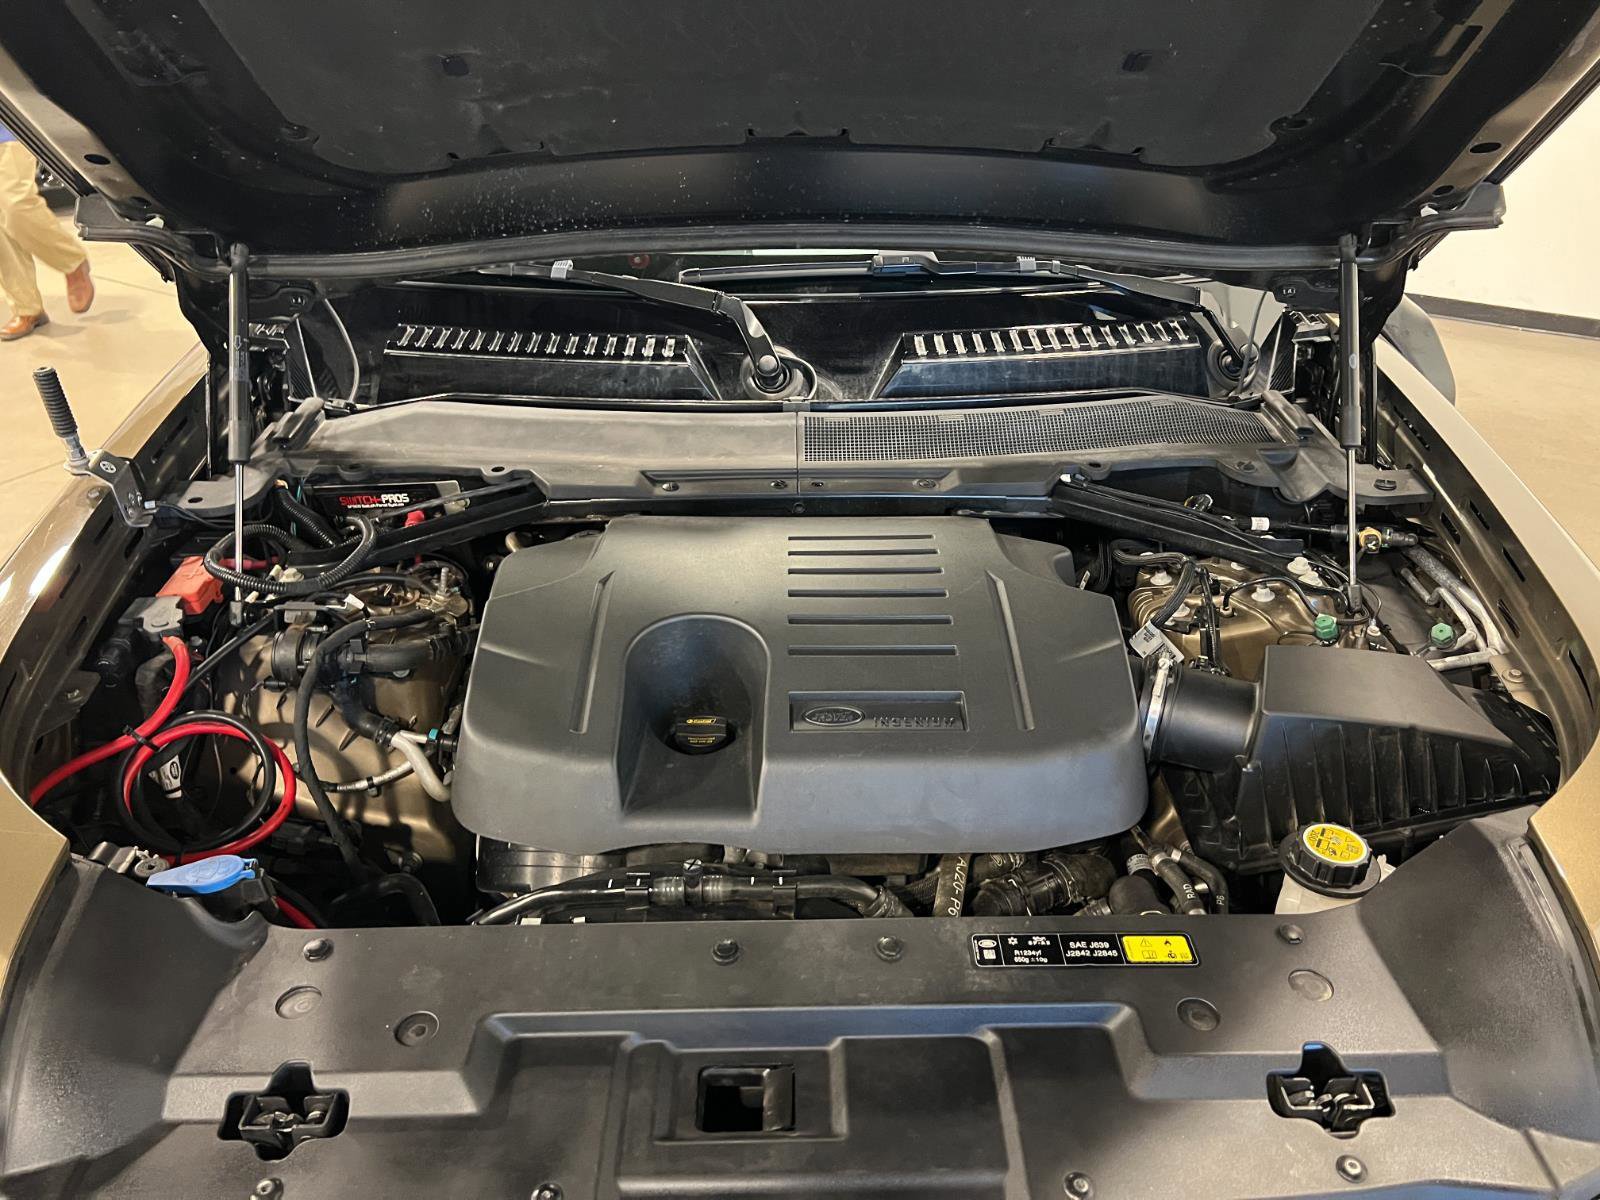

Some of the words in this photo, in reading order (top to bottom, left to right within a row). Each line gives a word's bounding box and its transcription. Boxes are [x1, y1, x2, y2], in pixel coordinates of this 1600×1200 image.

[339, 493, 410, 506] SWITCH-PROS
[1183, 883, 1197, 899] RAD
[1069, 941, 1087, 949] SAE
